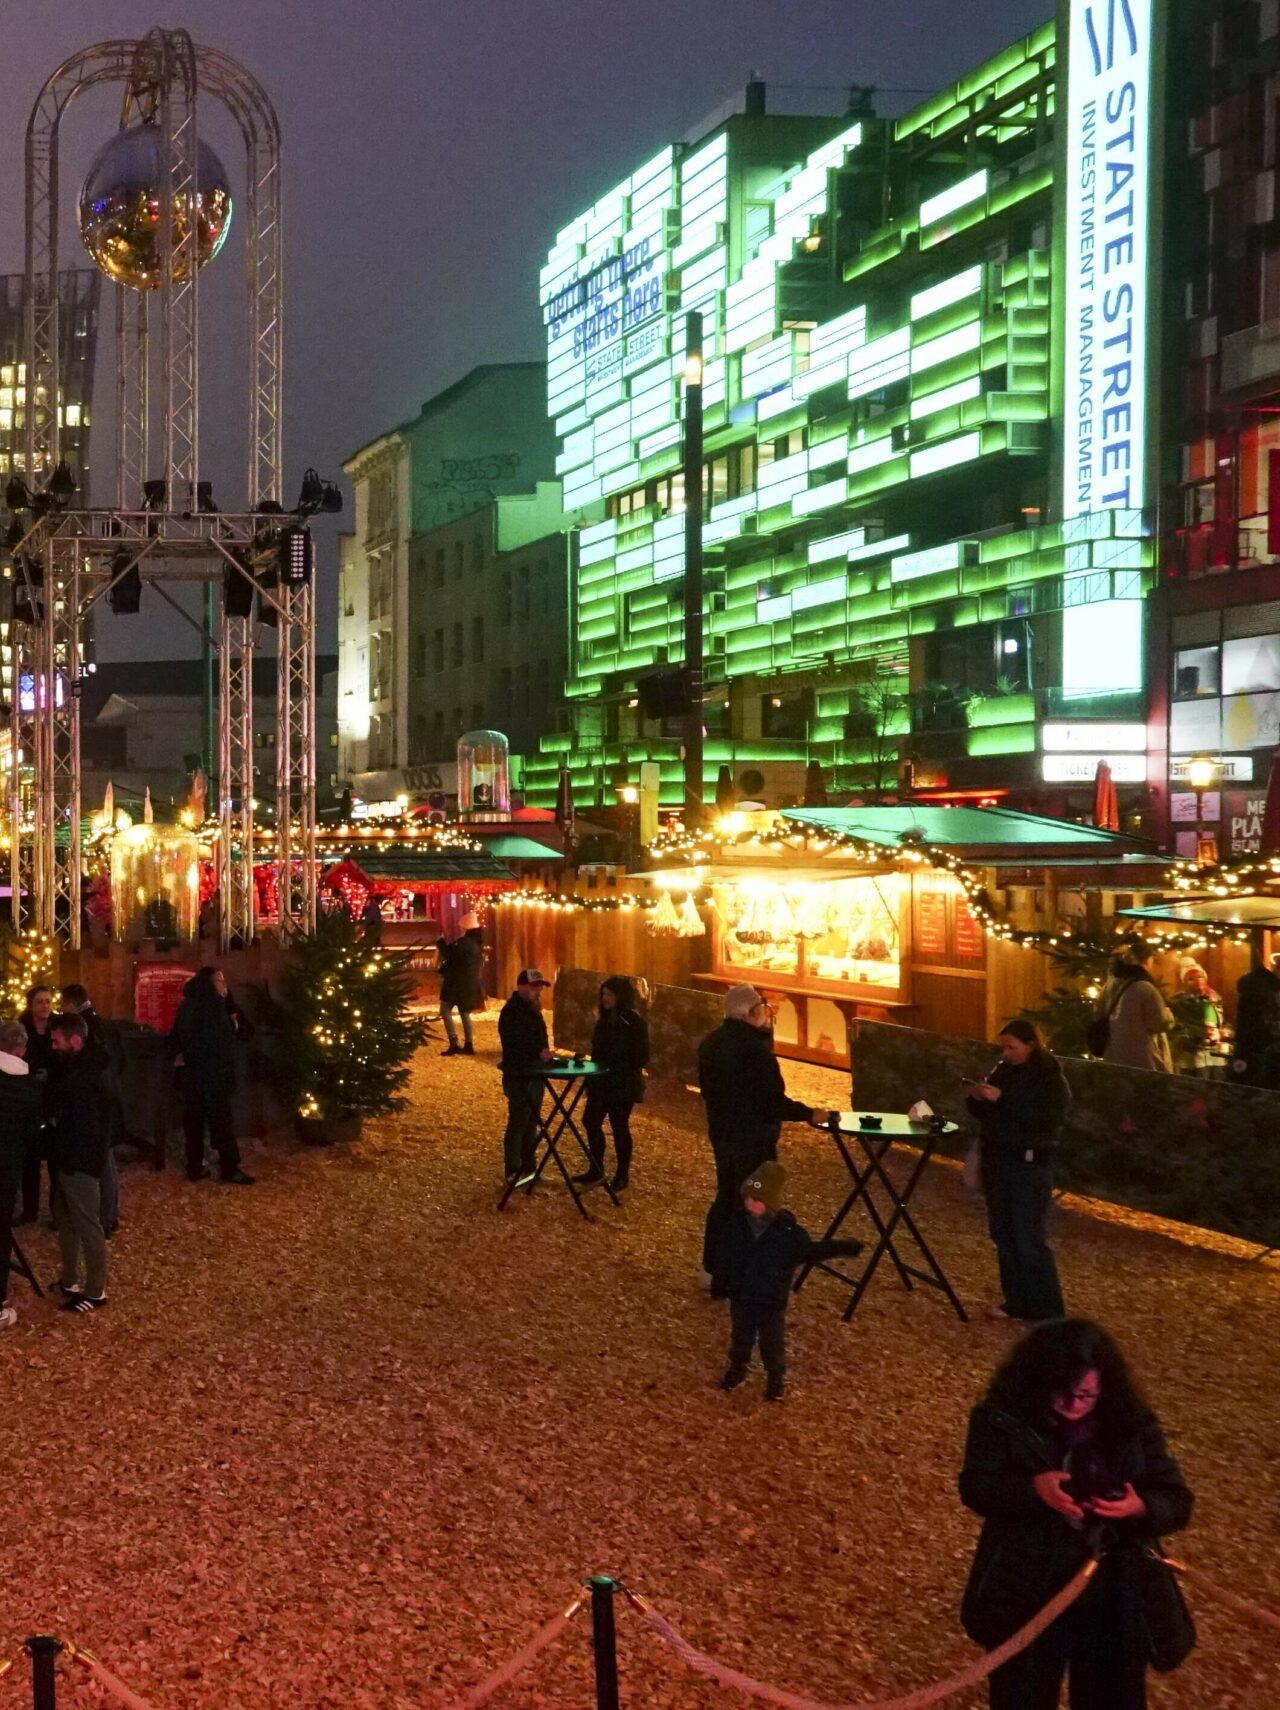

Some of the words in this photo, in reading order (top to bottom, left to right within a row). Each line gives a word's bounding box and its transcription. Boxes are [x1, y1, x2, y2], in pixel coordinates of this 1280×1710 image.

[1080, 100, 1096, 291] INVESTMENT
[1104, 81, 1136, 274] STATE
[1078, 305, 1094, 519] MANAGEMENT
[1102, 283, 1134, 511] STREET
[1232, 816, 1265, 838] PLA
[1247, 800, 1266, 815] ME
